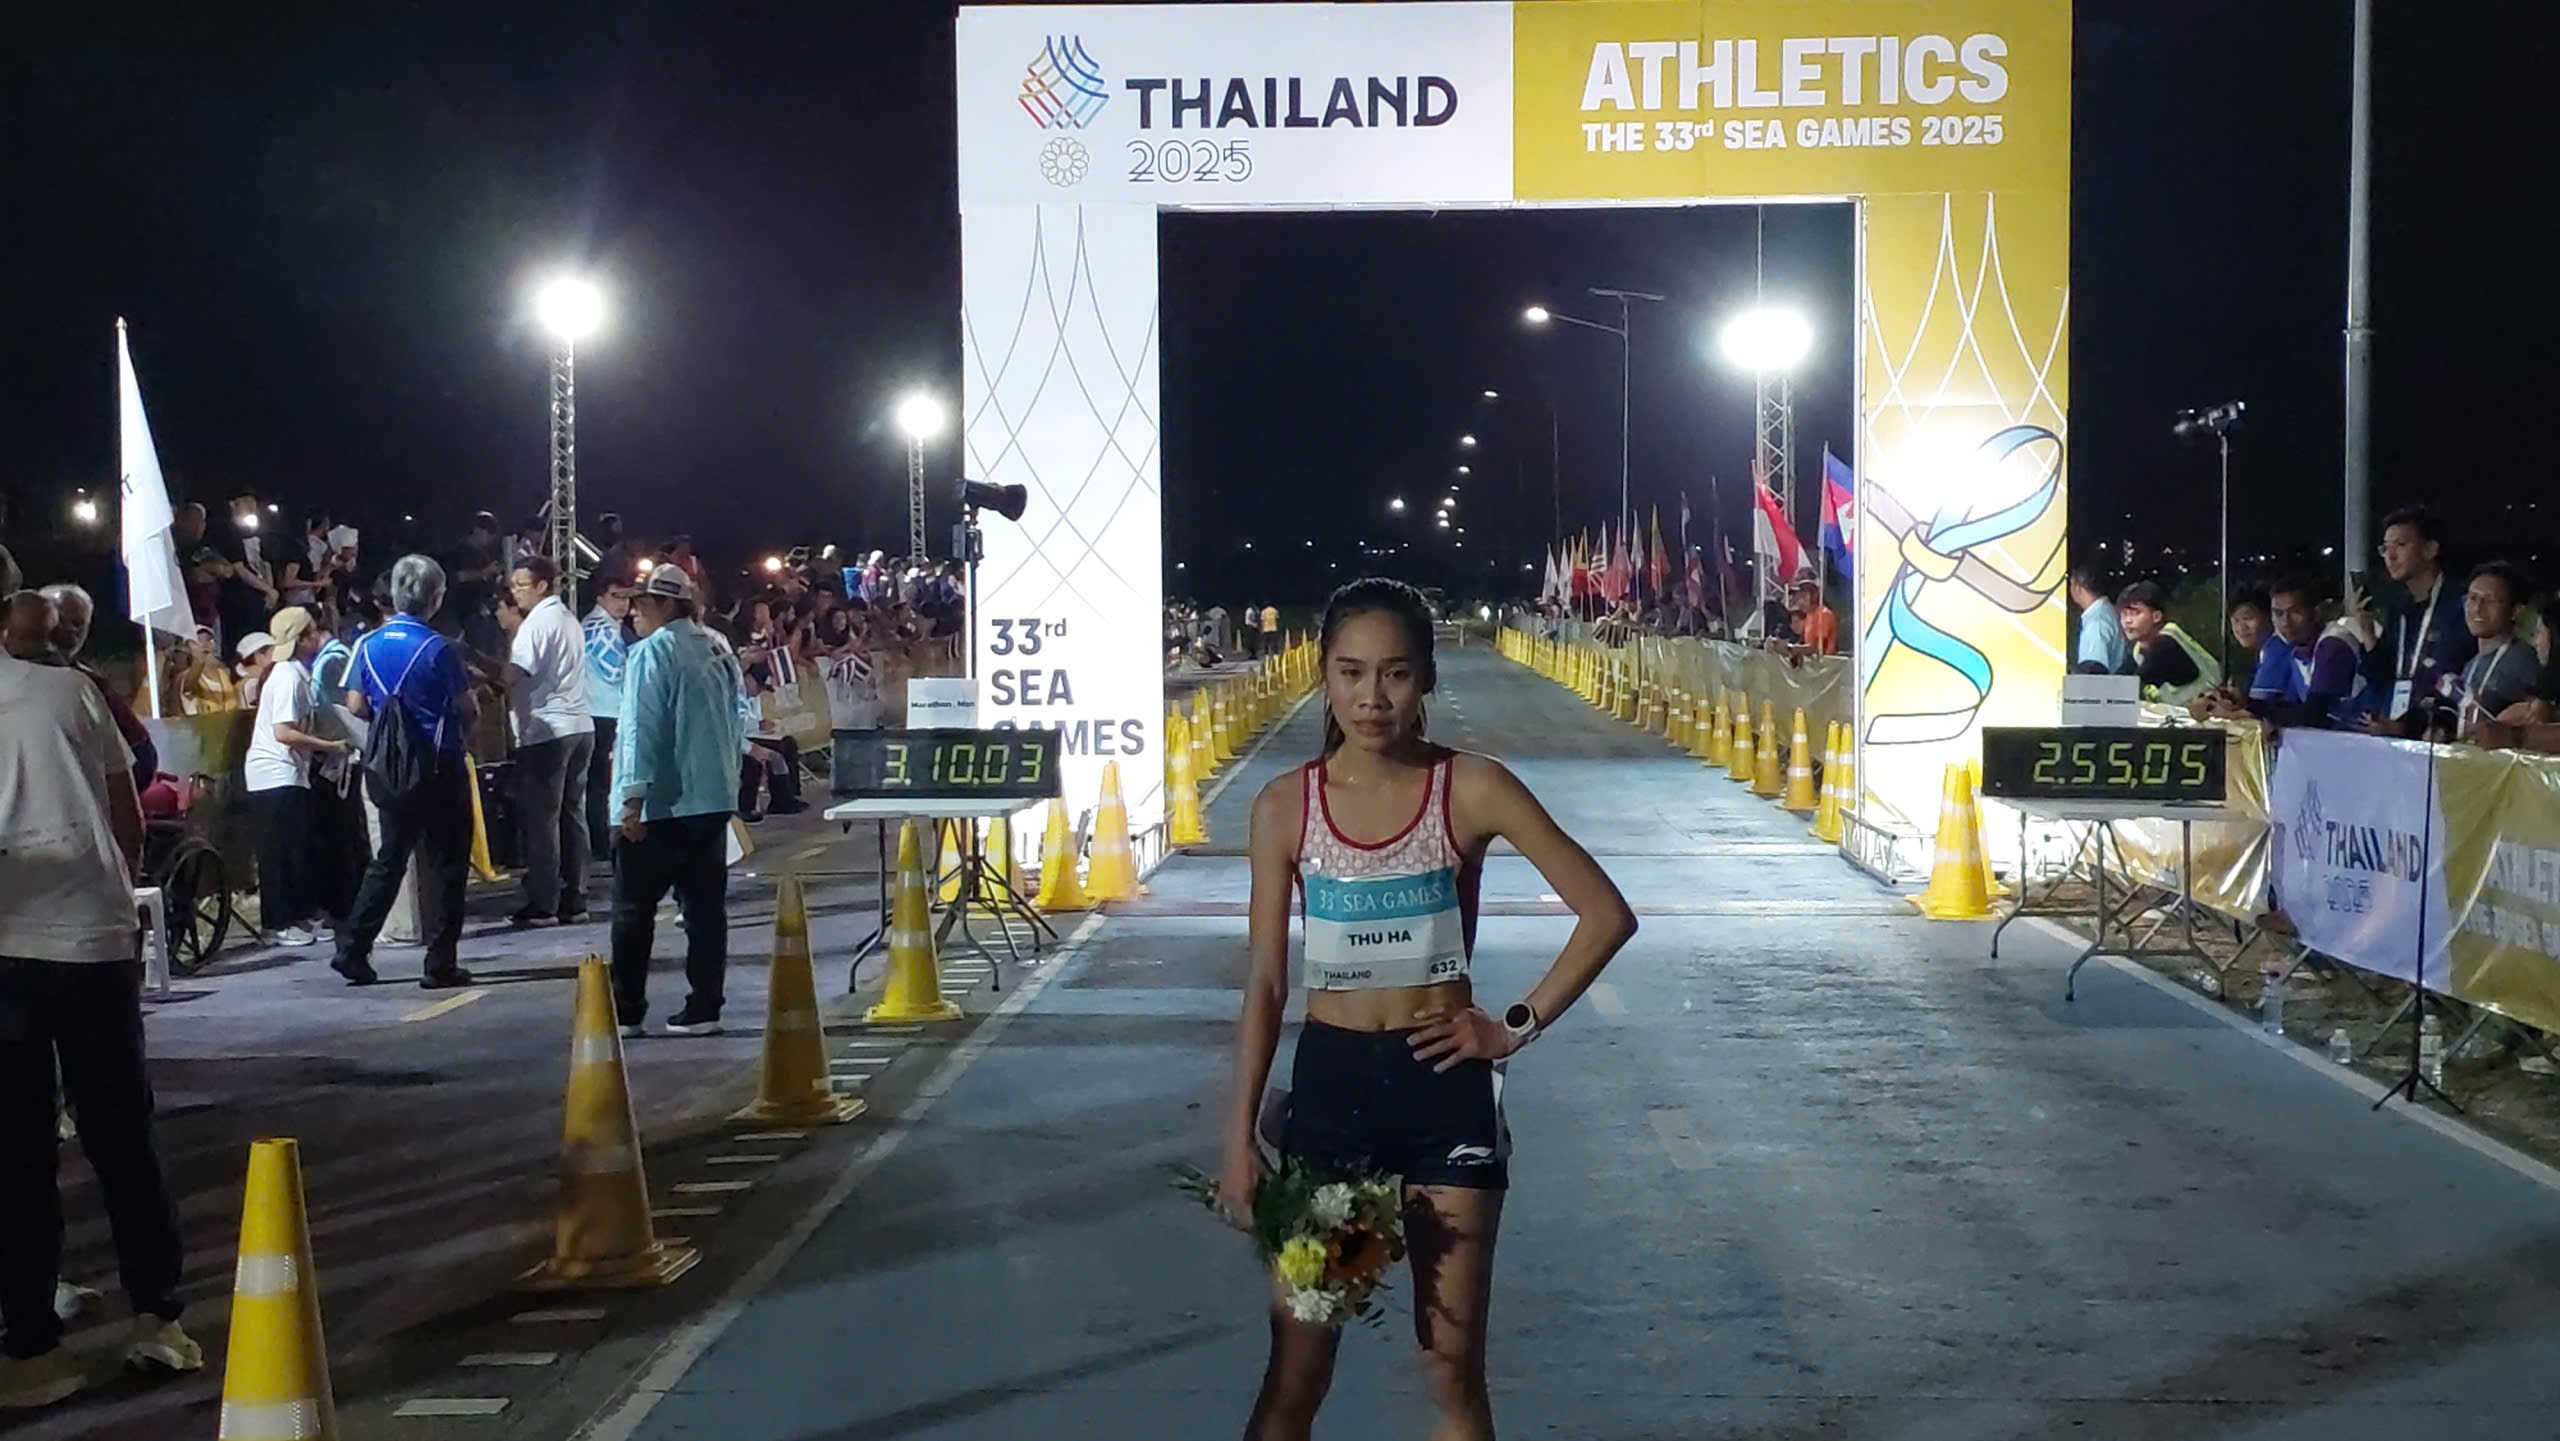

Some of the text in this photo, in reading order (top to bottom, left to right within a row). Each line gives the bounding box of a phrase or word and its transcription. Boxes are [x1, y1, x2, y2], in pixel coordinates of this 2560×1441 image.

[1580, 33, 2010, 112] ATHLETICS
[1125, 76, 1459, 129] THAILAND
[1581, 114, 2004, 152] THE 33rd SEA GAMES 2025
[1125, 139, 1253, 183] 2025
[989, 617, 1068, 656] 33rd
[990, 668, 1075, 706] SEA
[993, 718, 1145, 756] MES
[2326, 819, 2423, 883] THAILAND
[1343, 893, 1377, 913] SEA
[1383, 882, 1443, 910] GAMES
[1348, 929, 1413, 947] THU HA
[1323, 968, 1373, 981] THAILAND
[1430, 959, 1459, 975] 632
